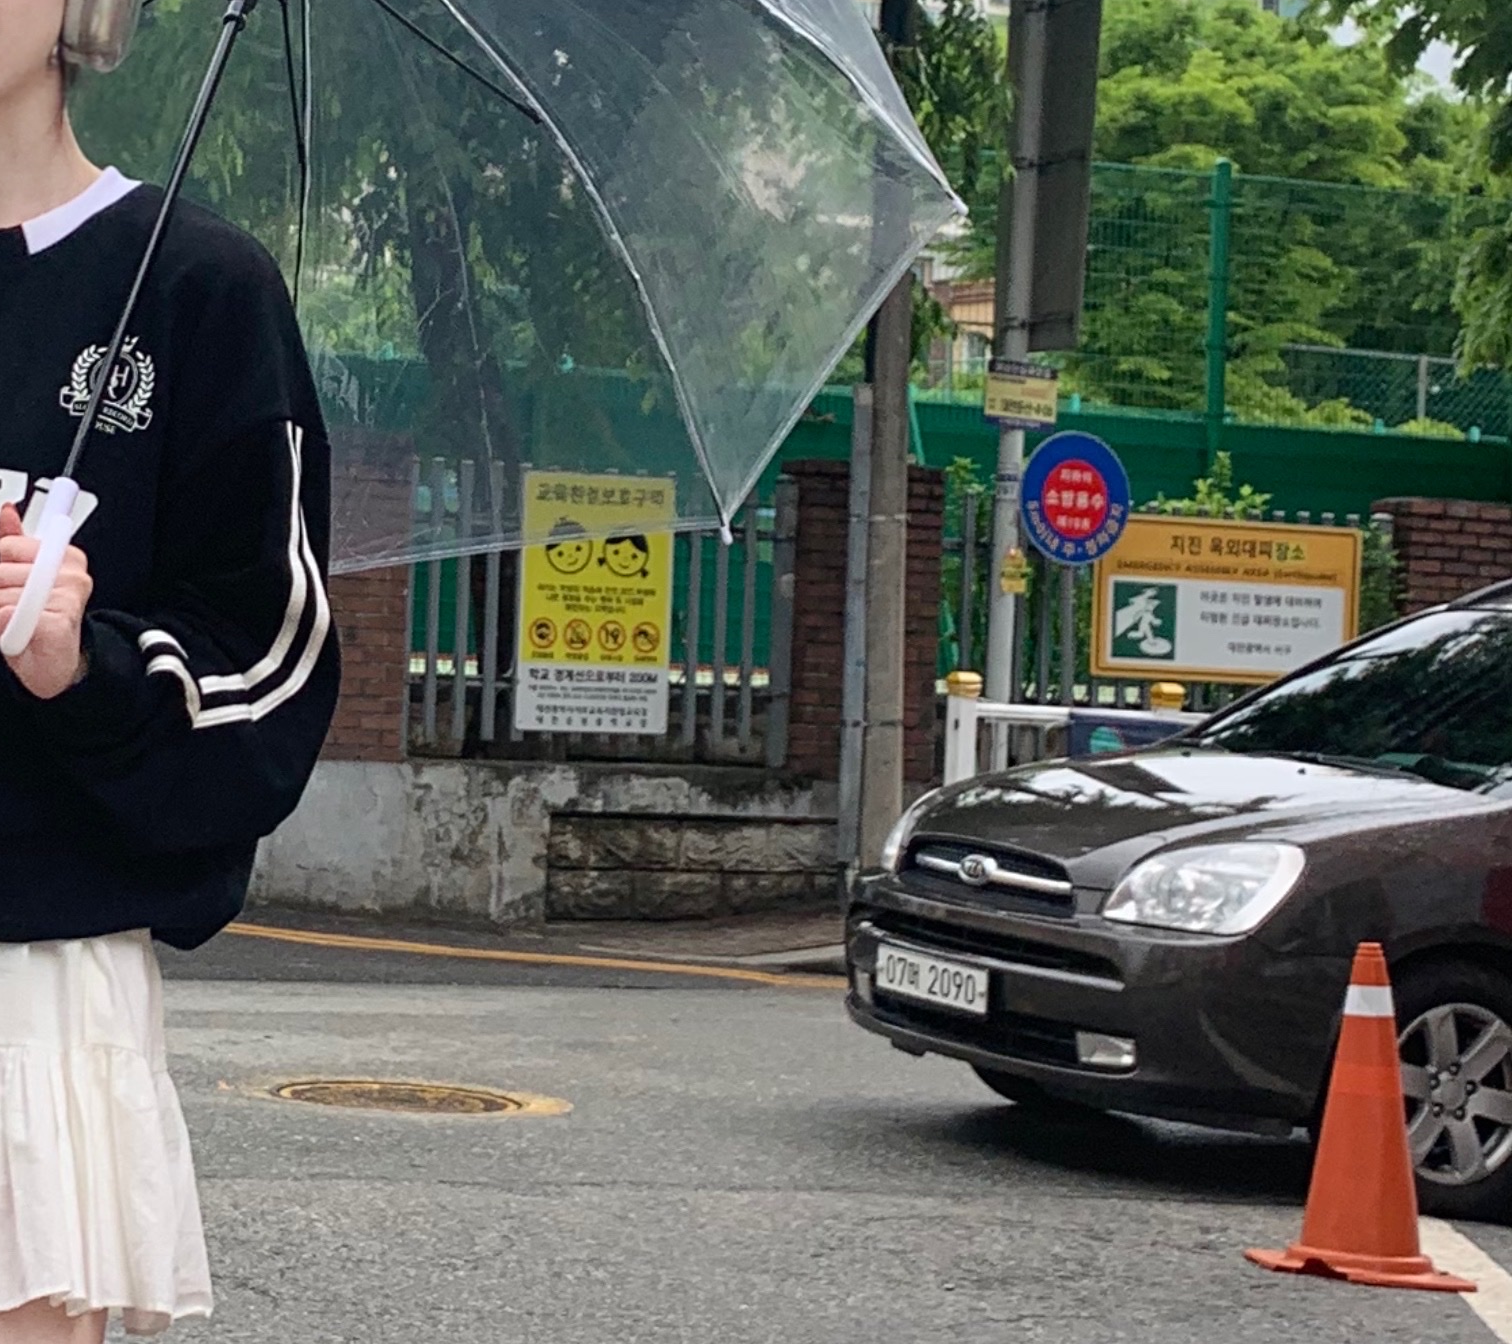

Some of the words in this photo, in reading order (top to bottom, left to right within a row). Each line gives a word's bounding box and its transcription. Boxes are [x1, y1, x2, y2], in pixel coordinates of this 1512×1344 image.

[1045, 489, 1104, 510] 소방용수
[1170, 534, 1202, 555] 지진
[1209, 536, 1307, 561] 옥외대피장소
[528, 668, 550, 681] 학교
[927, 964, 977, 1005] 2090
